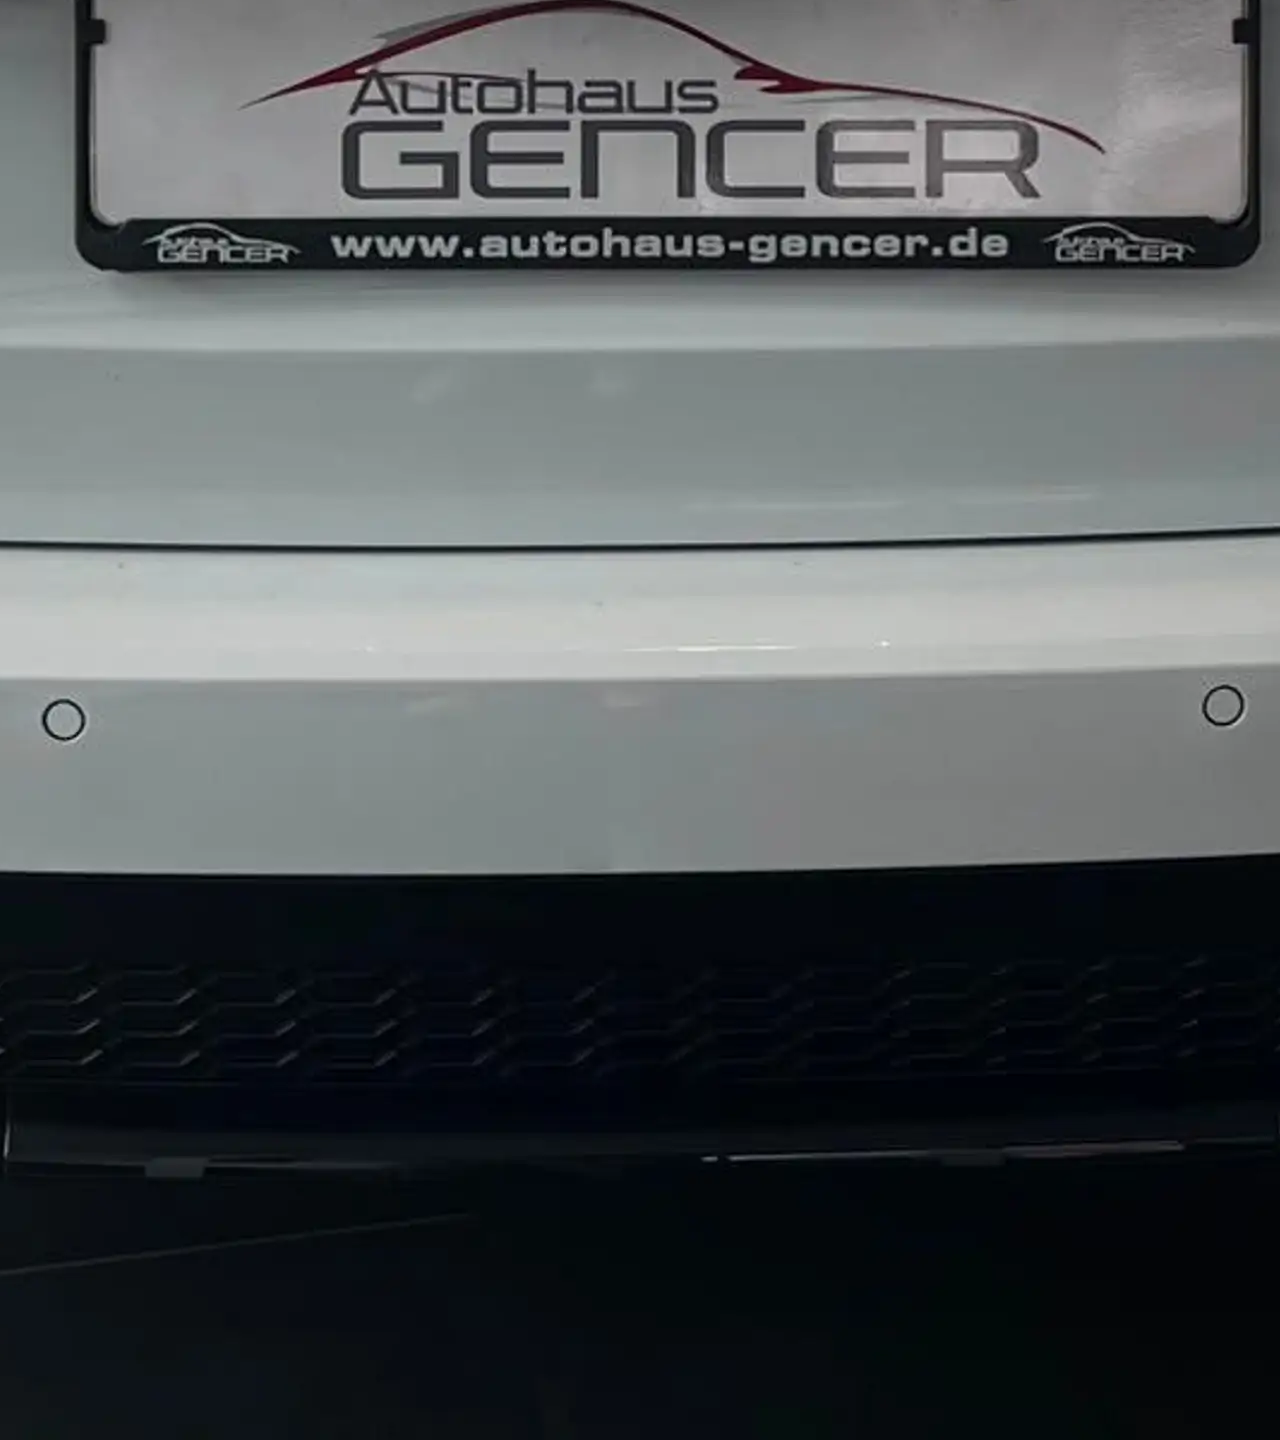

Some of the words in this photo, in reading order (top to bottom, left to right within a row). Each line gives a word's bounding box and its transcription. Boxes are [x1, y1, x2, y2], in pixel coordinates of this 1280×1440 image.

[348, 69, 720, 115] Autohaus
[341, 119, 1042, 200] GENCER
[157, 245, 289, 263] GENCER
[331, 227, 1009, 263] www.autohaus-gencer.de
[1055, 244, 1184, 262] GENCER
